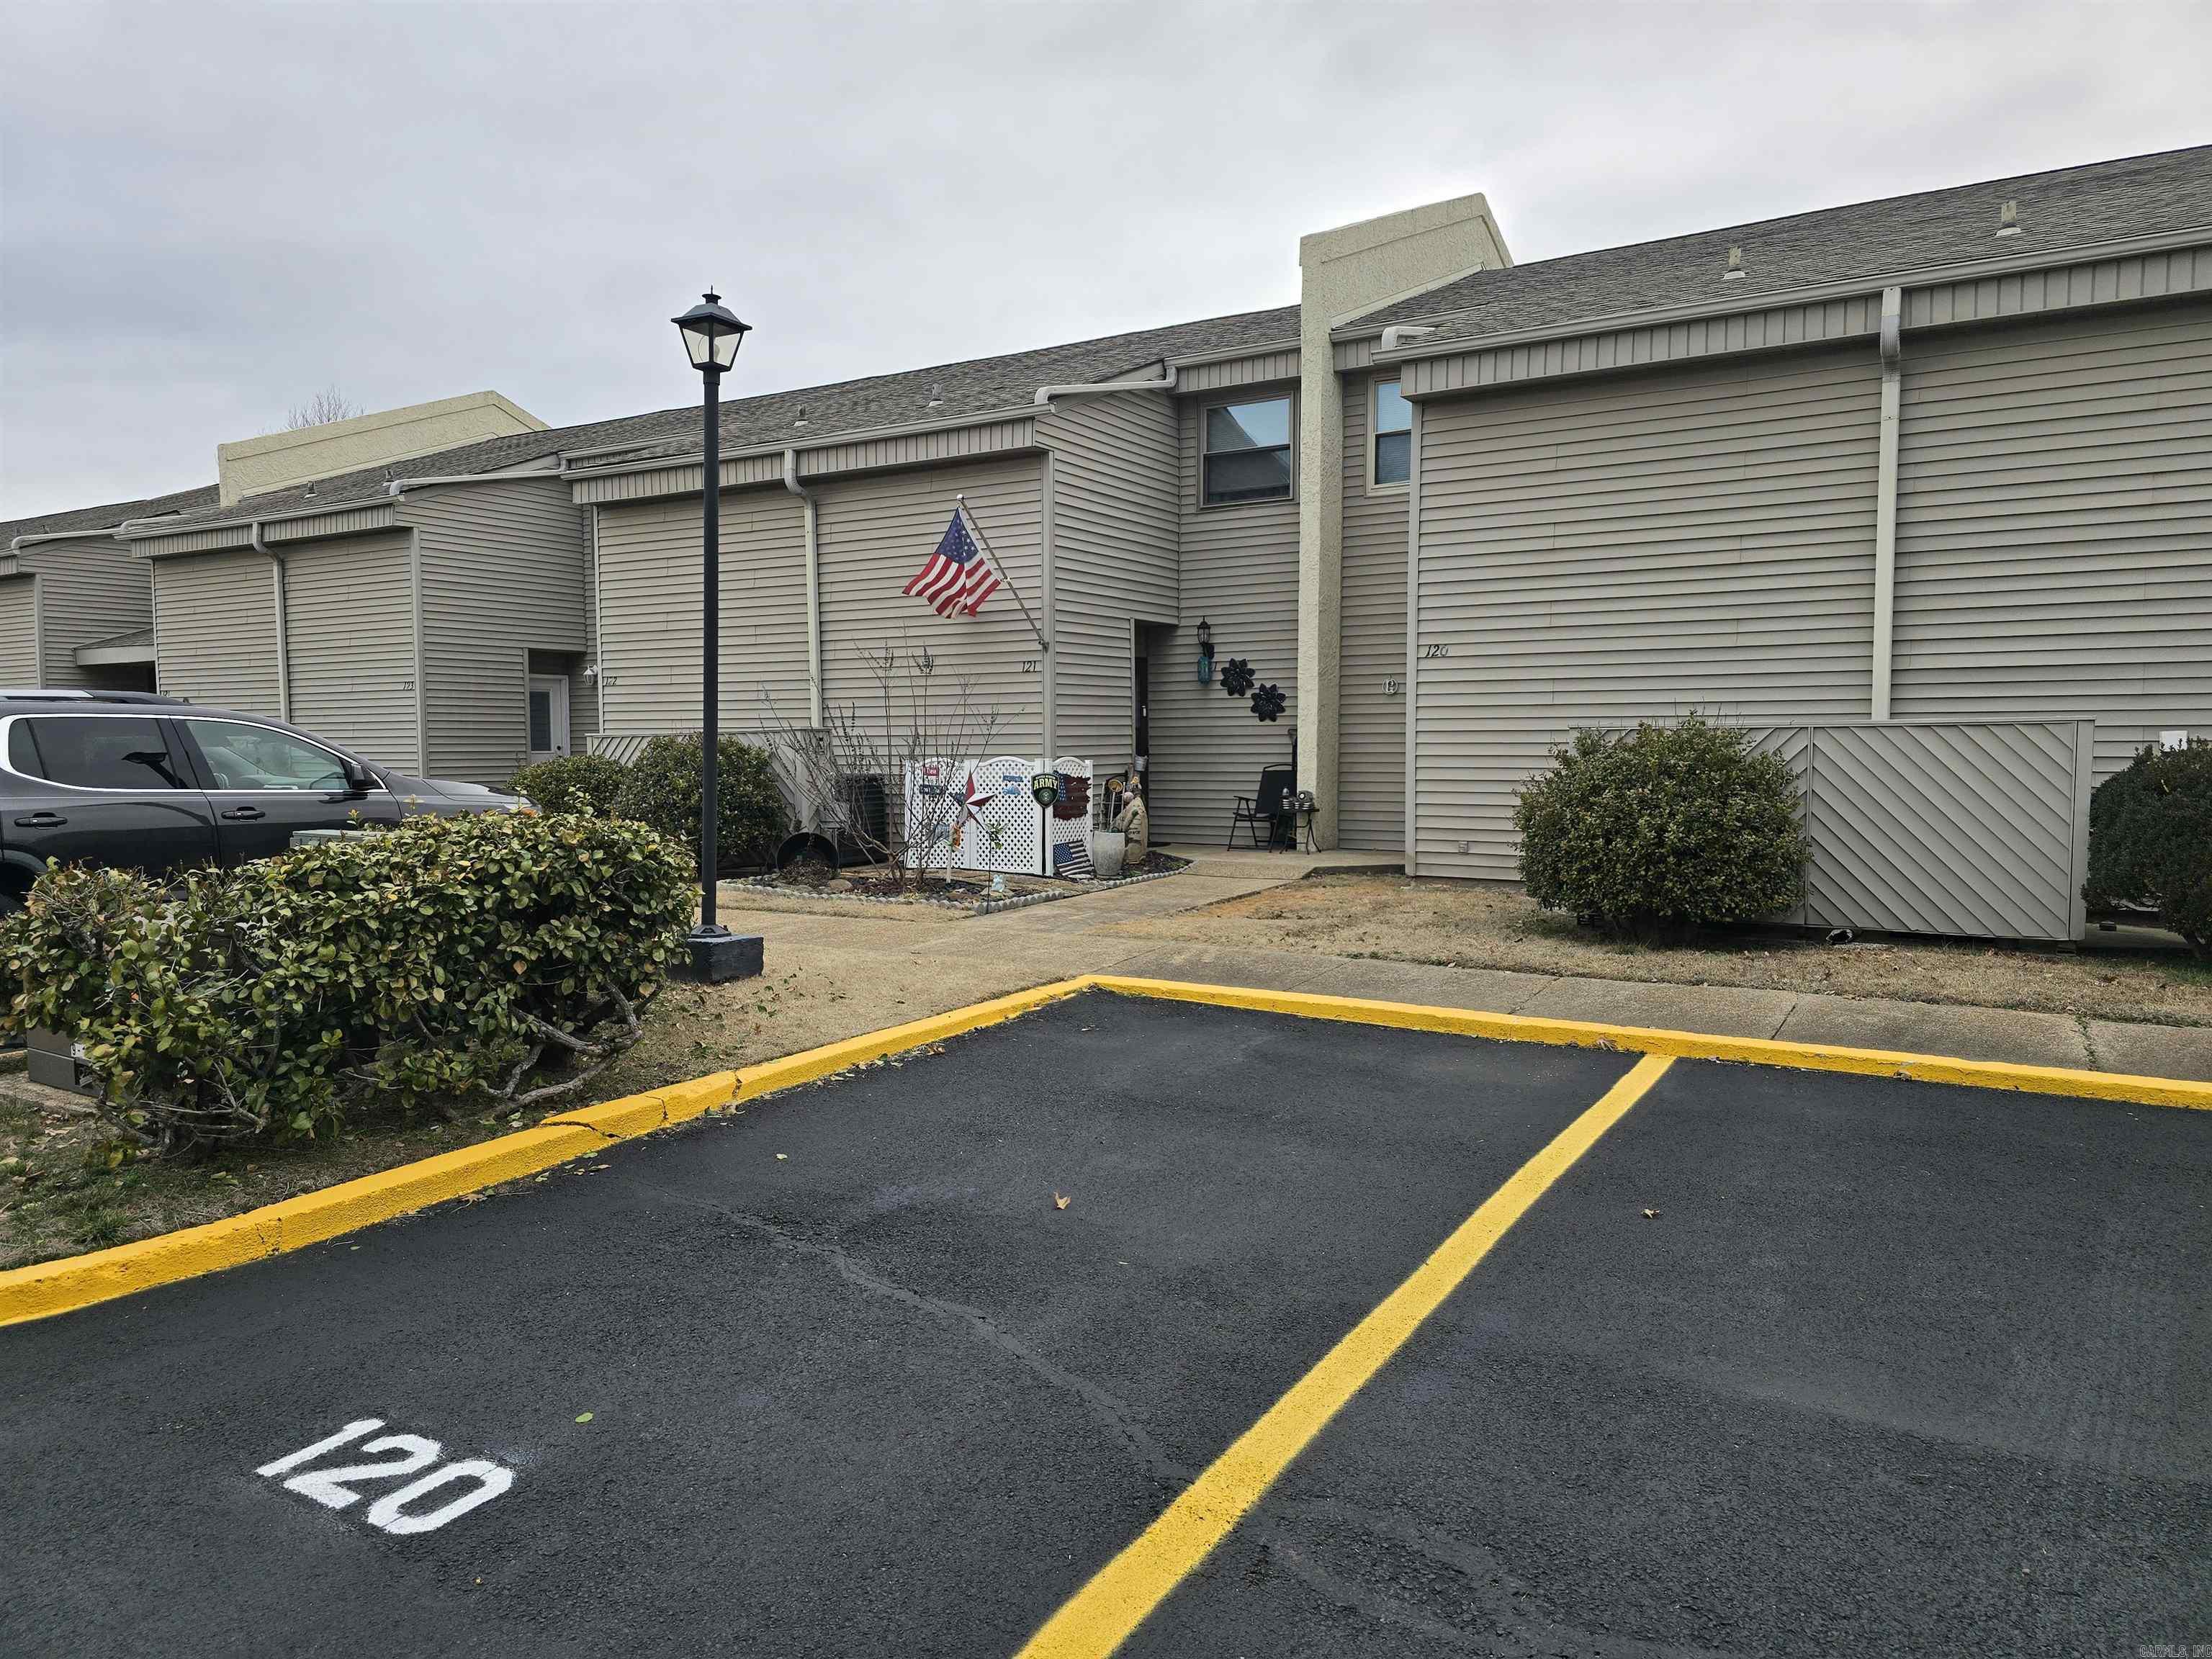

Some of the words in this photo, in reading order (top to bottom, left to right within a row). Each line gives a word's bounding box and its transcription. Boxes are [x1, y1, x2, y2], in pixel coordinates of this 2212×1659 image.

[1426, 644, 1449, 657] 120
[1022, 660, 1037, 673] 121
[1033, 778, 1058, 791] ARMY
[253, 1417, 515, 1534] 120
